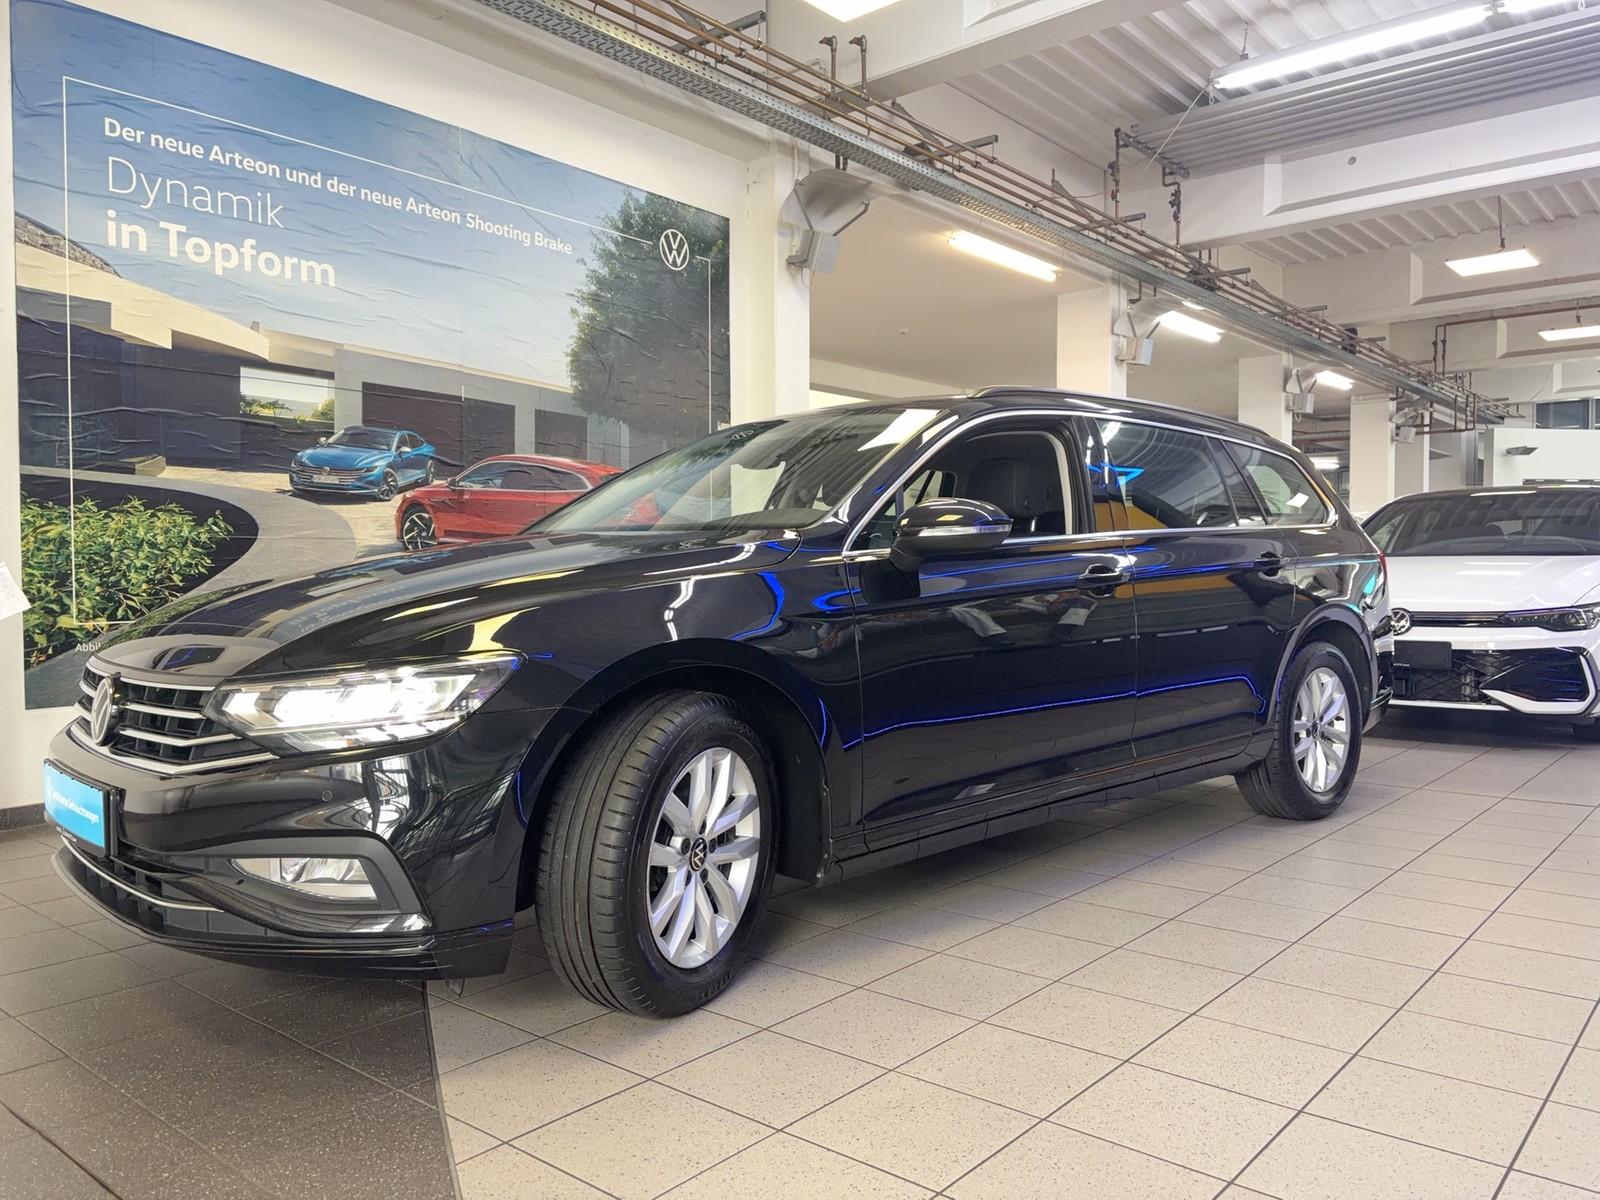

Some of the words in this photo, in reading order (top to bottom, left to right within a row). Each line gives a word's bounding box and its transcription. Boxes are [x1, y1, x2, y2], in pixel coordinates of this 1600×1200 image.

[104, 116, 146, 143] Der
[149, 132, 205, 159] neue
[208, 144, 281, 178] Arteon
[285, 167, 322, 189] und
[326, 176, 357, 197] der
[360, 186, 403, 210] neue
[405, 196, 461, 225] Arteon
[466, 212, 531, 247] Shooting
[534, 231, 573, 255] Brake
[108, 155, 285, 229] Dynamik
[106, 208, 148, 253] in
[159, 220, 336, 288] Topform
